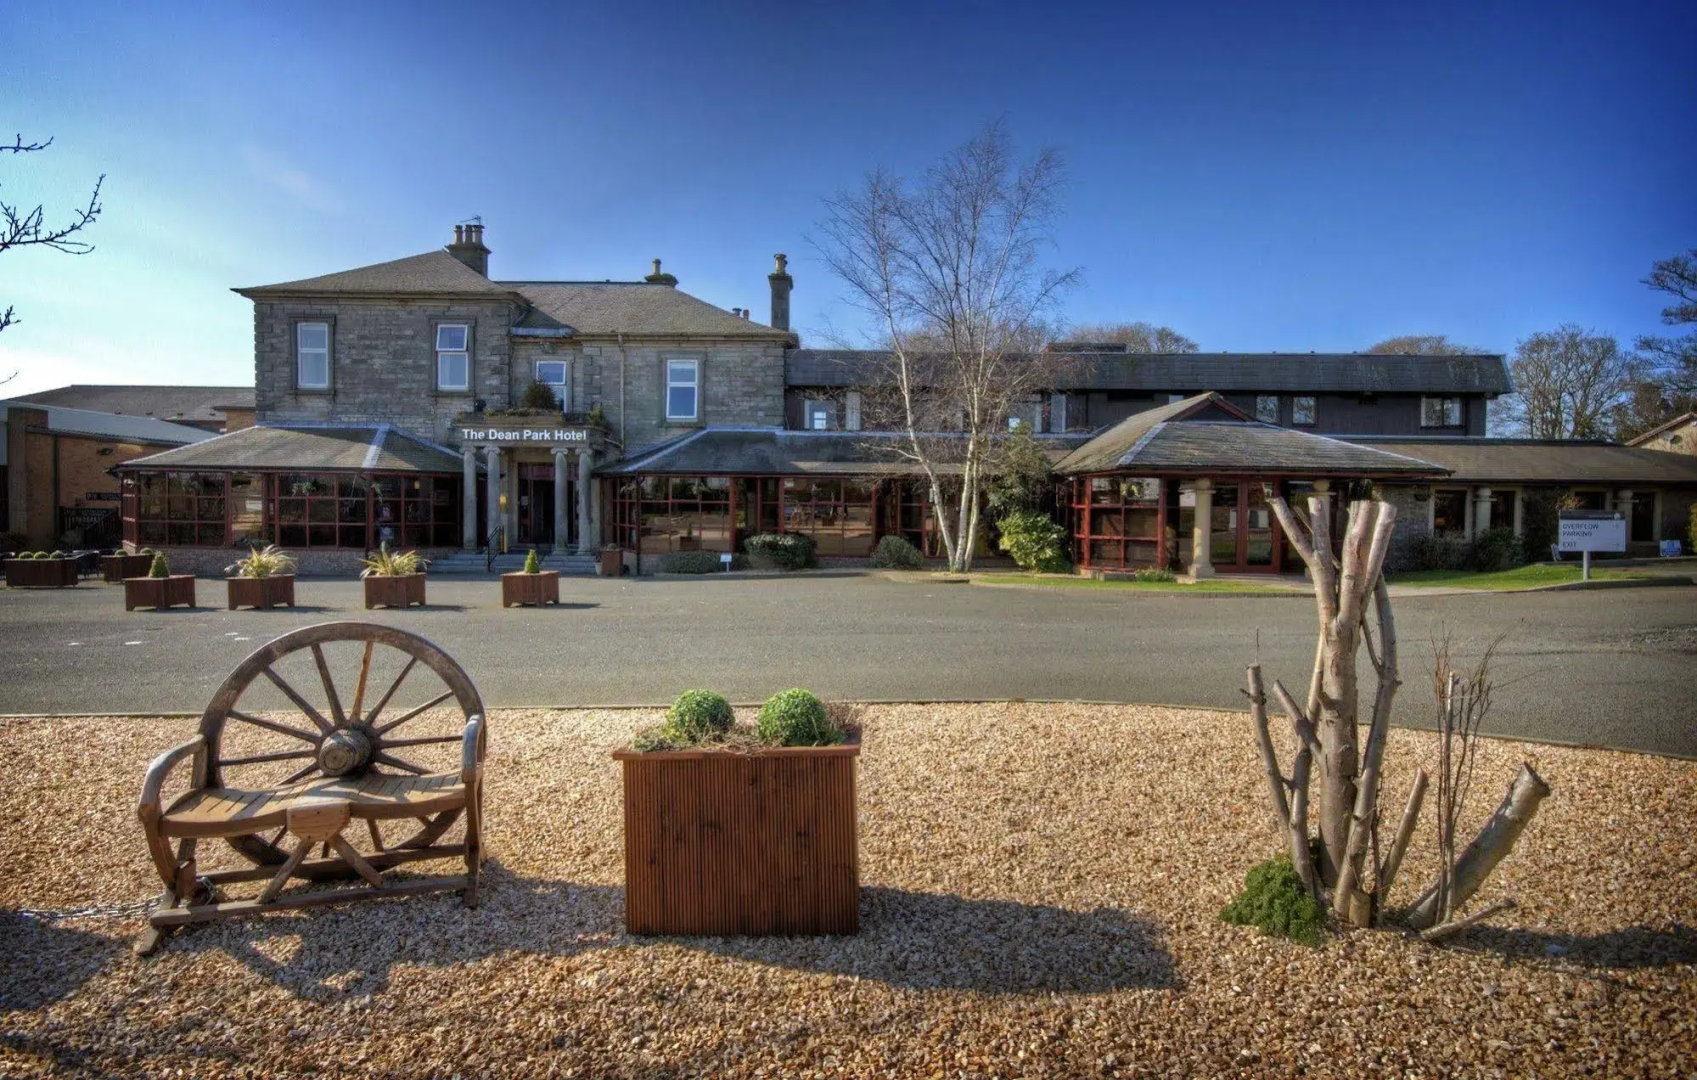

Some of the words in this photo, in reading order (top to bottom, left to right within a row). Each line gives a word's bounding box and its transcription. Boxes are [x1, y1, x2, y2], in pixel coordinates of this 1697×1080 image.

[462, 428, 485, 440] The
[488, 429, 520, 440] Dean
[523, 429, 551, 440] Park
[554, 430, 587, 440] Hotel
